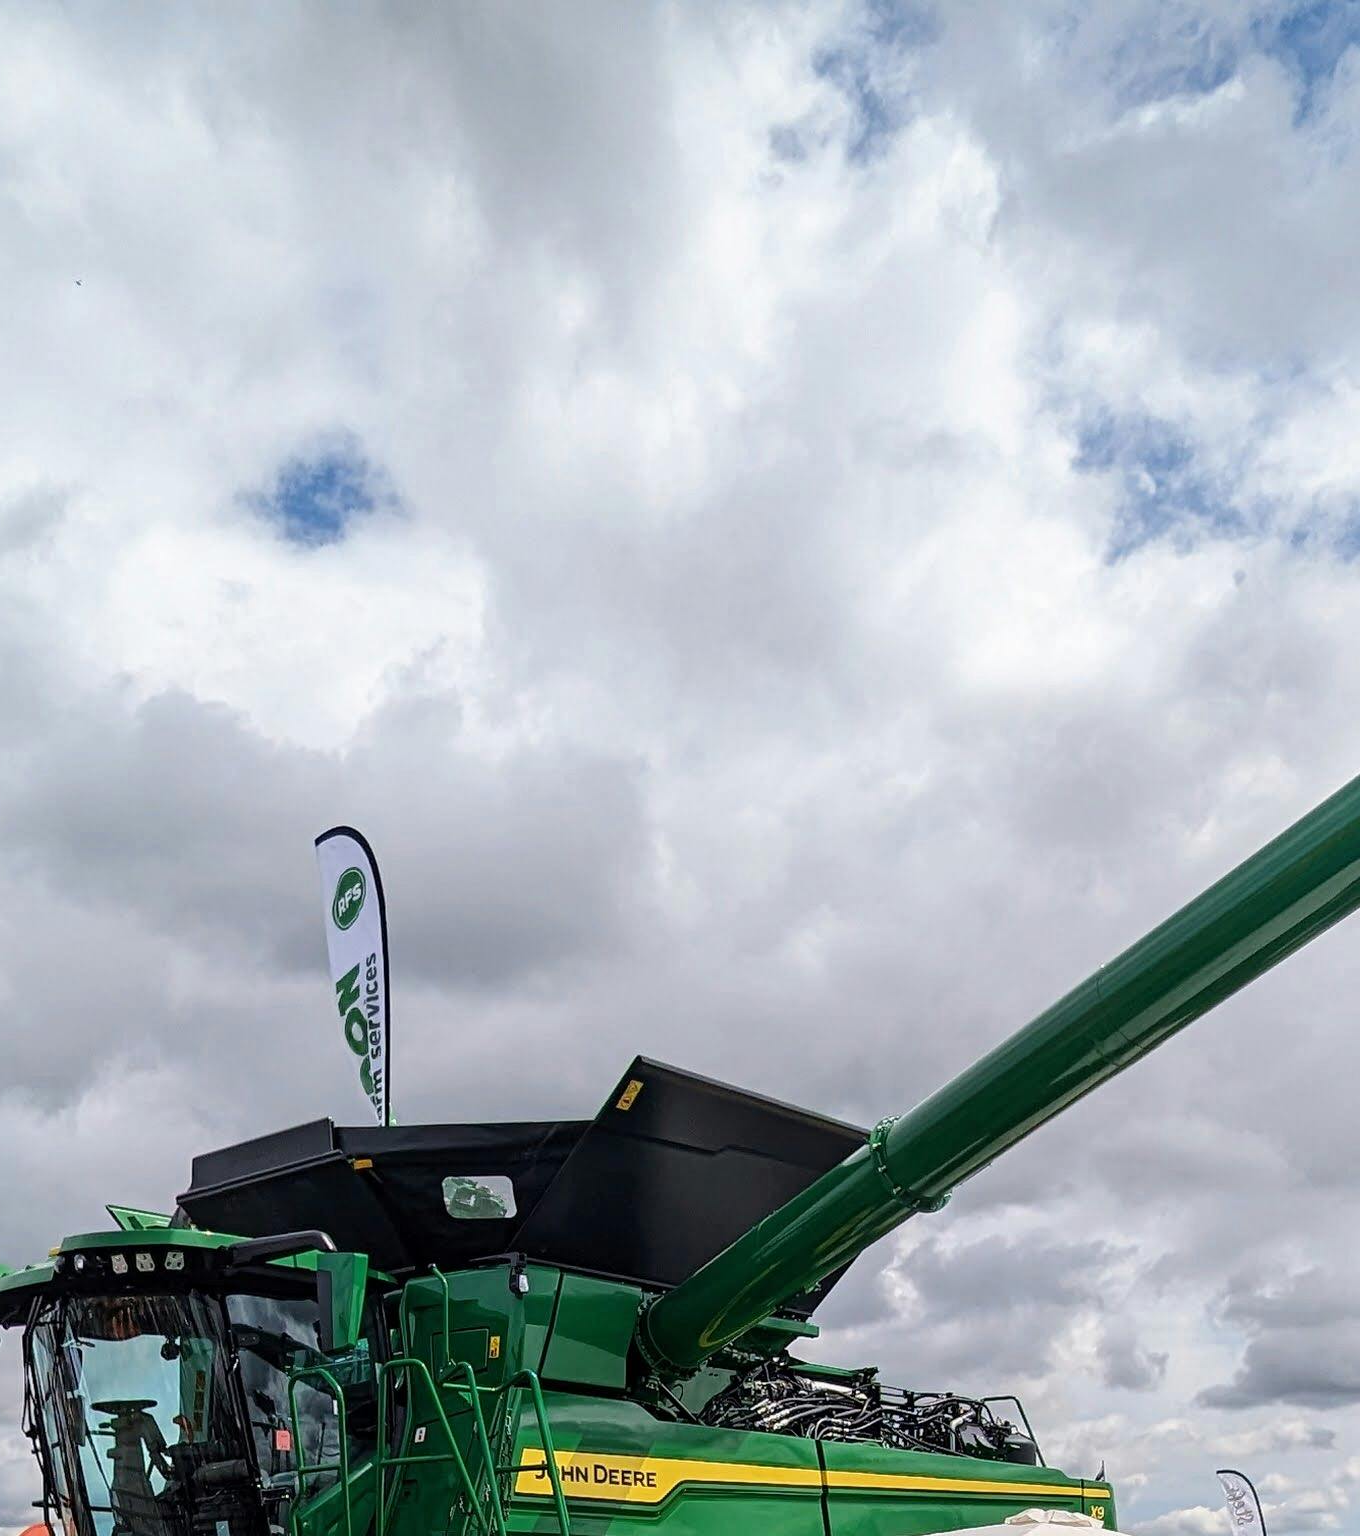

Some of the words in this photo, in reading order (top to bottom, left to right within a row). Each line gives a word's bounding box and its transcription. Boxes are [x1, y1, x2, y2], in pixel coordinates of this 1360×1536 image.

[338, 883, 362, 917] RFS
[366, 952, 383, 1060] services
[593, 1464, 657, 1488] DEERE
[1091, 1504, 1105, 1521] X9
